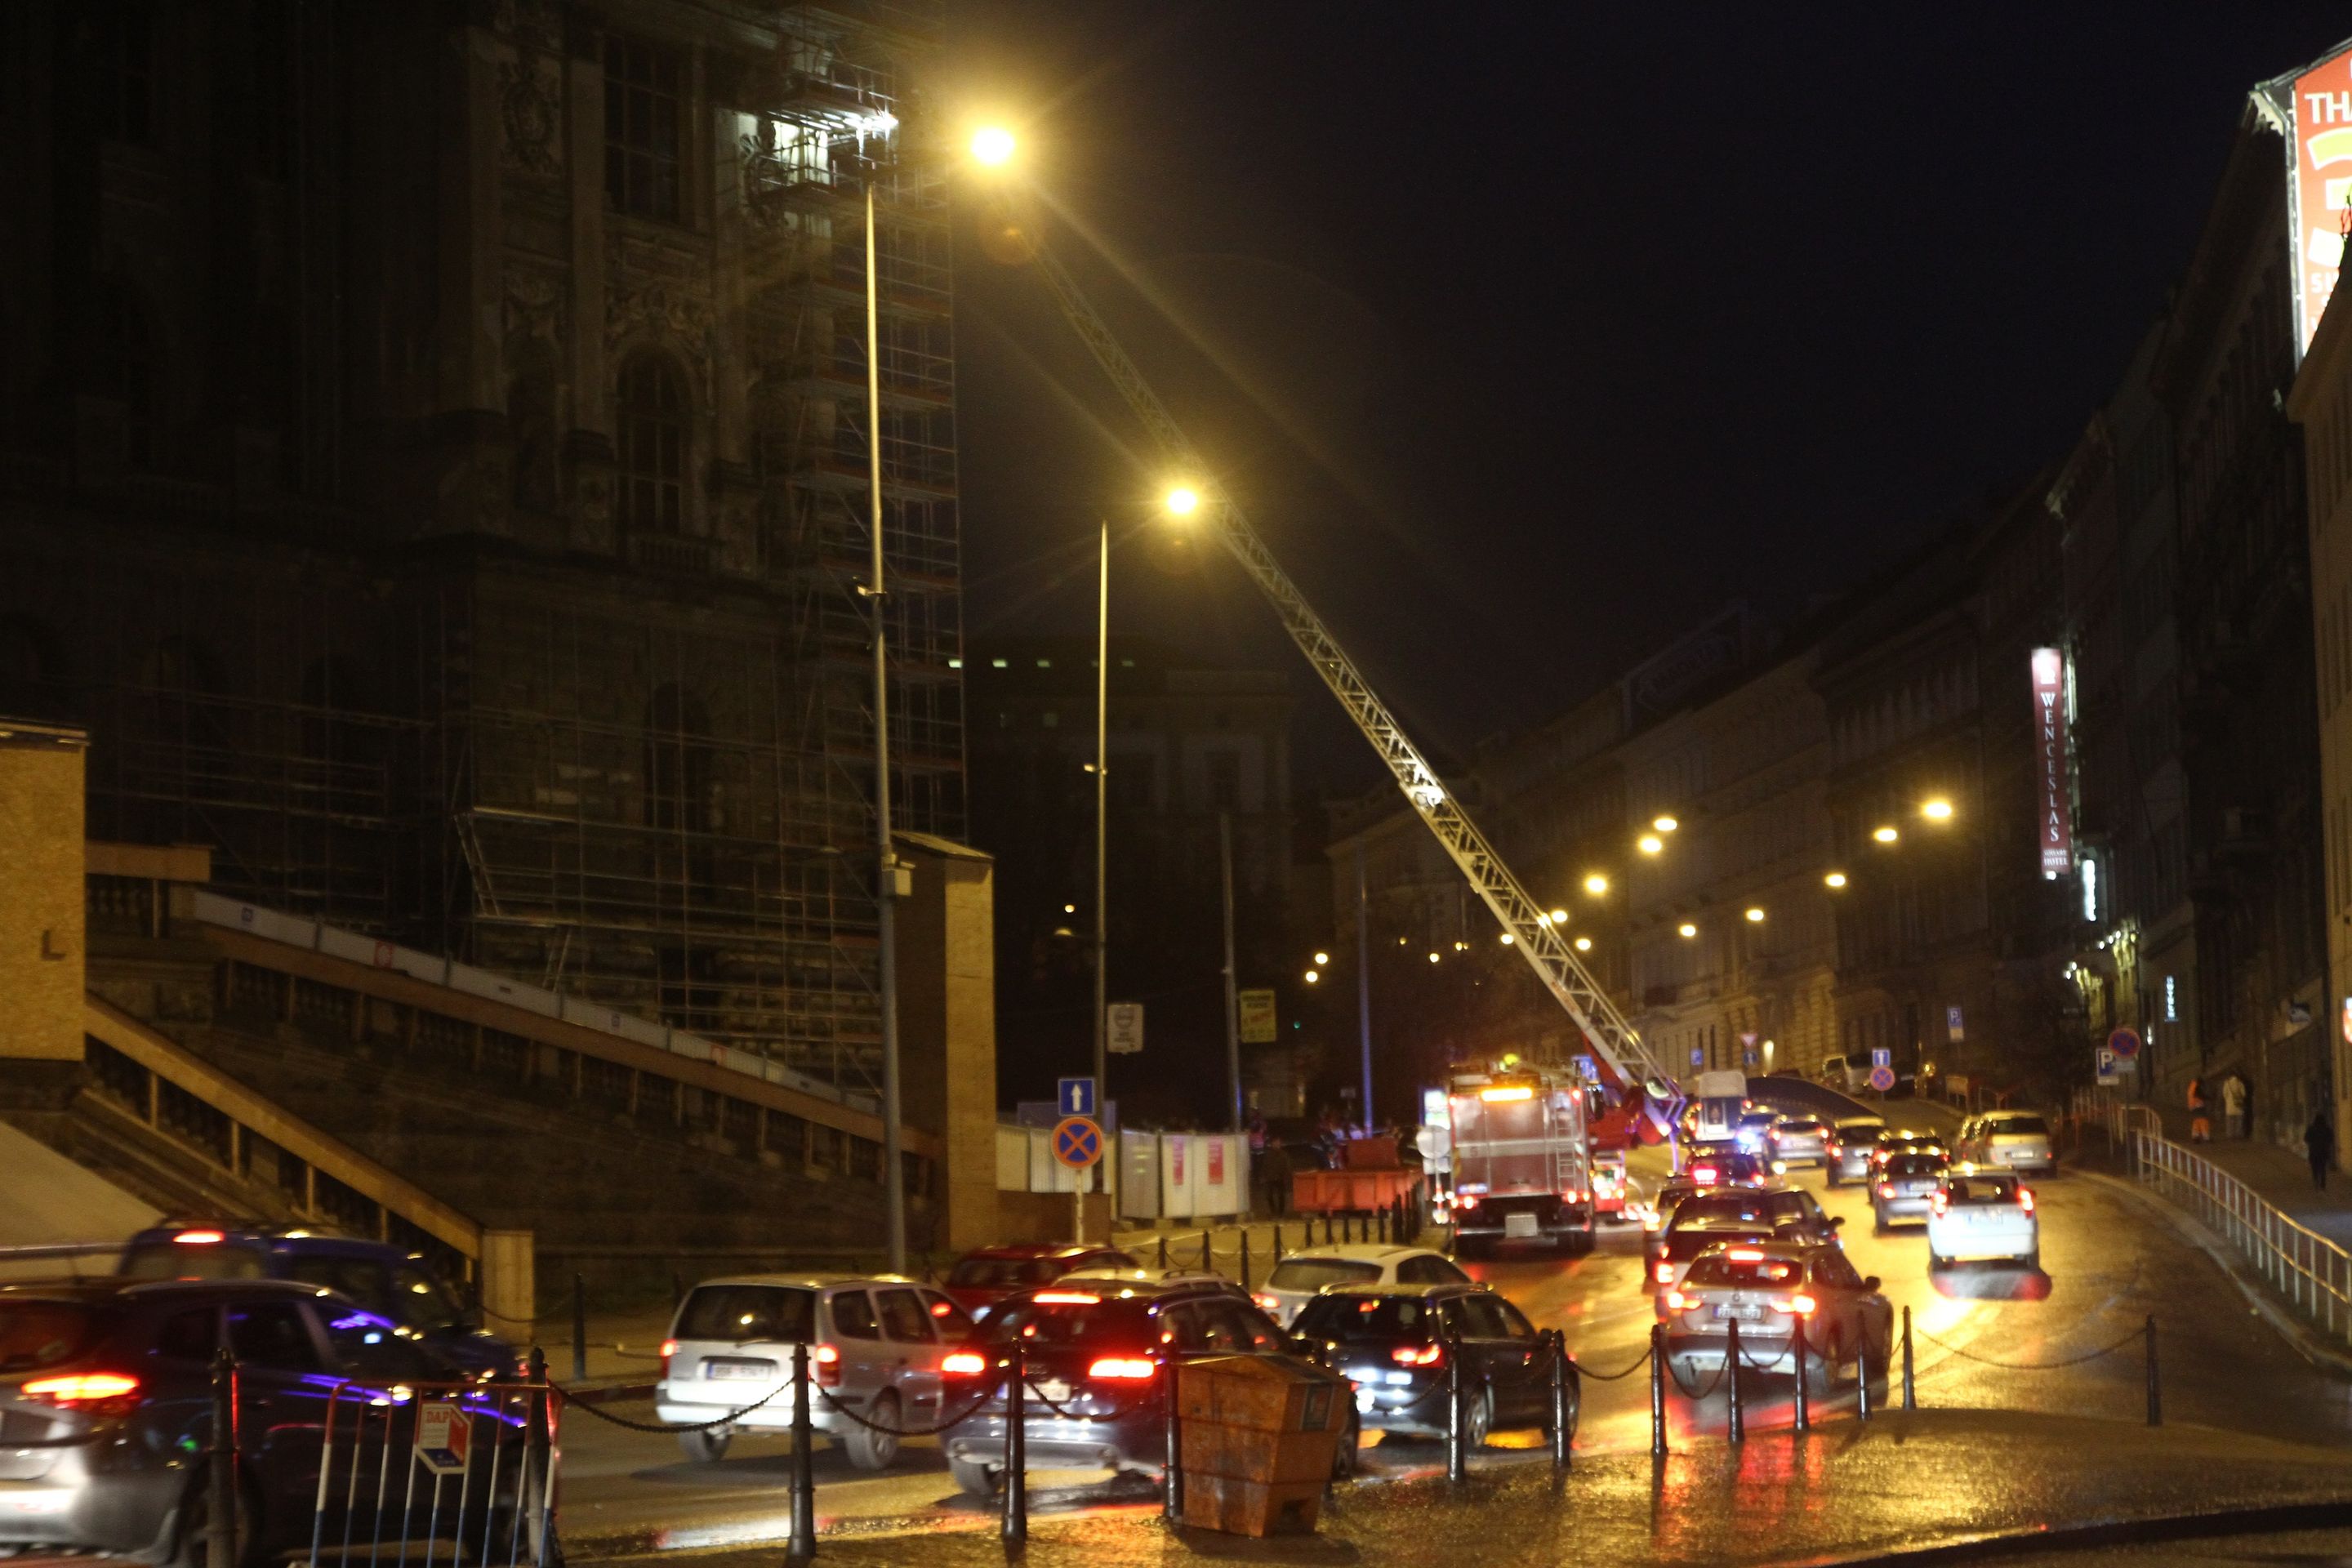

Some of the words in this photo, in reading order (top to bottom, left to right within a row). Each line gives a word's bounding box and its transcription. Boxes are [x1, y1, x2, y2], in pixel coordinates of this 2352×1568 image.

[2304, 91, 2352, 123] TH
[2040, 692, 2060, 842] WENCESLAS
[2043, 857, 2069, 866] HOTEL
[2100, 1051, 2114, 1069] P
